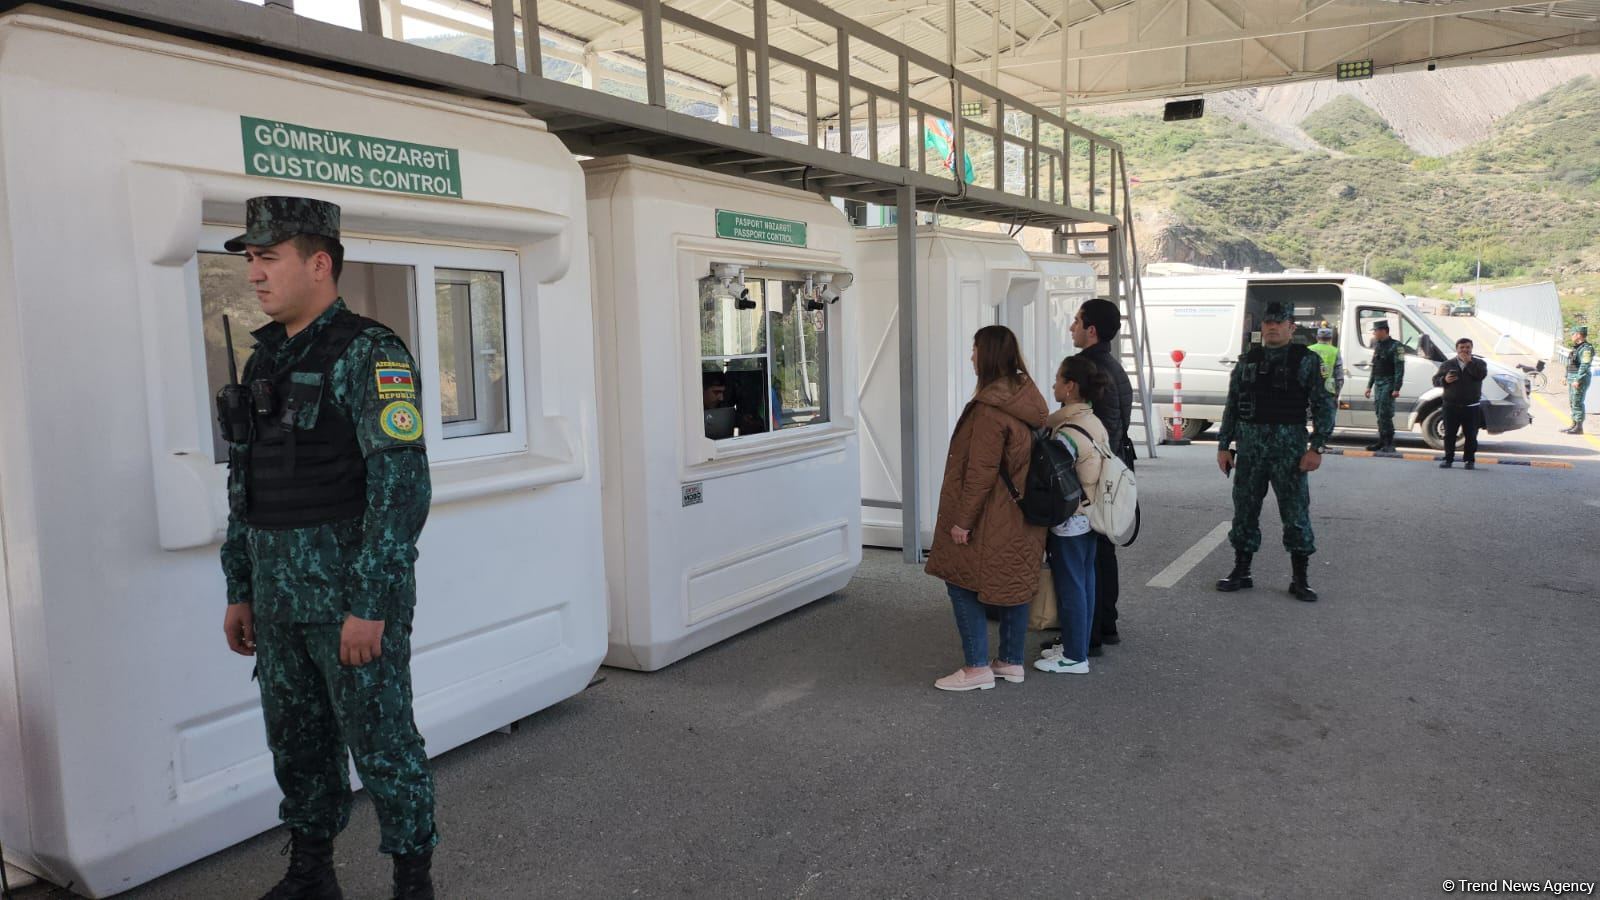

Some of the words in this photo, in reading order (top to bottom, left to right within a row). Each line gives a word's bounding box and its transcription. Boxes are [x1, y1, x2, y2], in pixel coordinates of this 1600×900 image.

[254, 123, 354, 157] GÖMRÜK
[358, 141, 451, 171] NƏZARƏTİ
[253, 152, 364, 185] CUSTOMS
[370, 169, 457, 195] CONTROL
[734, 228, 765, 240] PASSPORT
[766, 232, 793, 243] CONTROL
[735, 217, 763, 229] PASPORT
